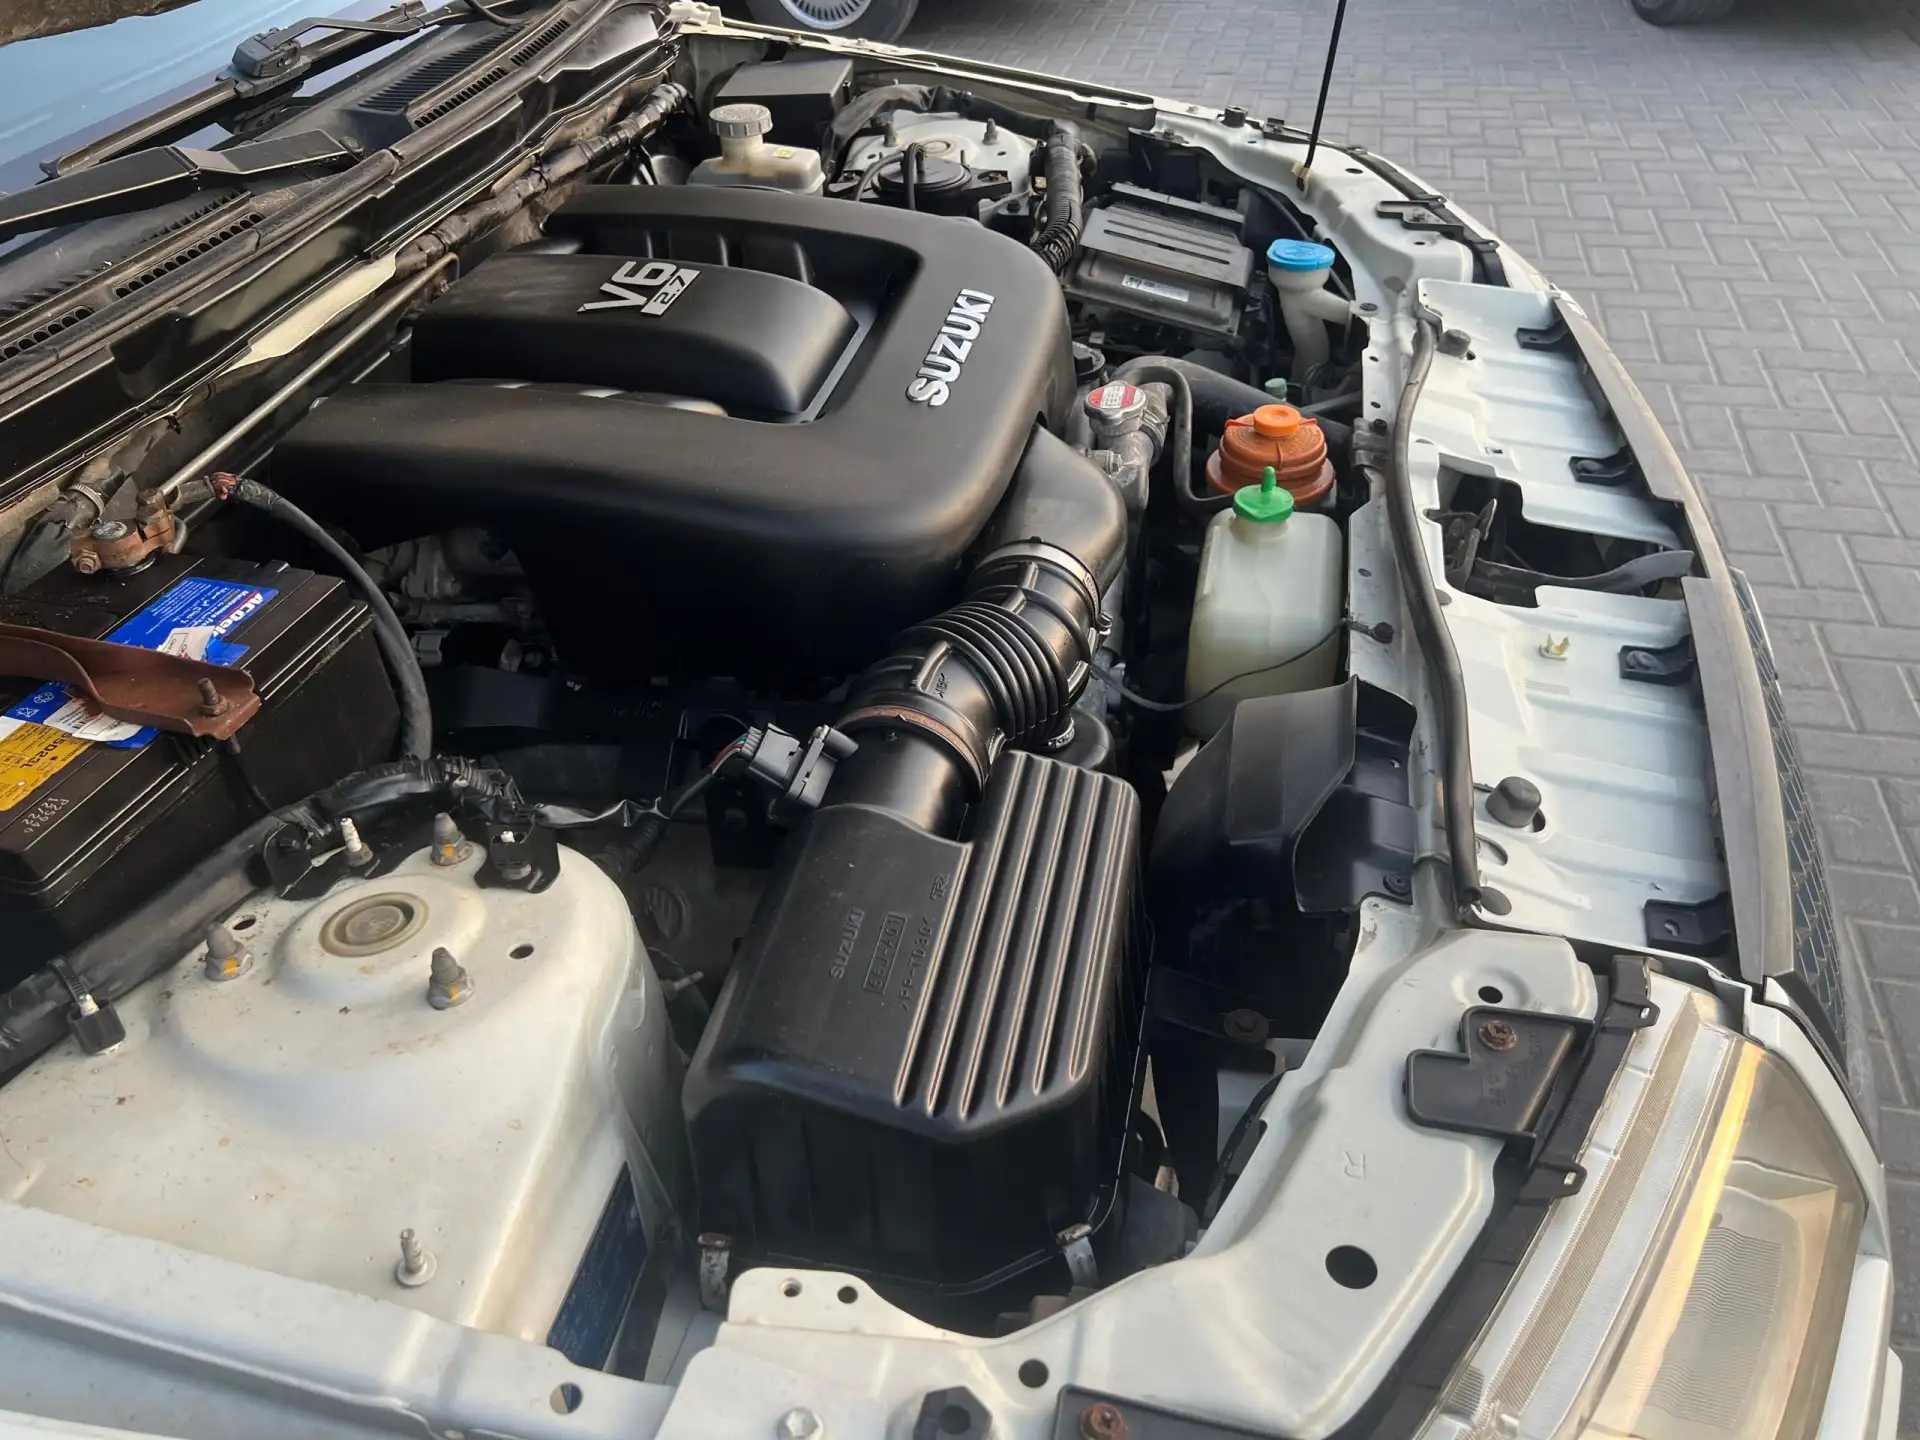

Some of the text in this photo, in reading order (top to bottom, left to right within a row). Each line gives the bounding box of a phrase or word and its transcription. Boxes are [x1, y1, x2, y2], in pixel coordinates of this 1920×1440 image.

[577, 261, 678, 314] V6
[906, 288, 996, 407] SUZUKI
[21, 797, 59, 825] 12/22
[829, 908, 865, 979] SUZUKI
